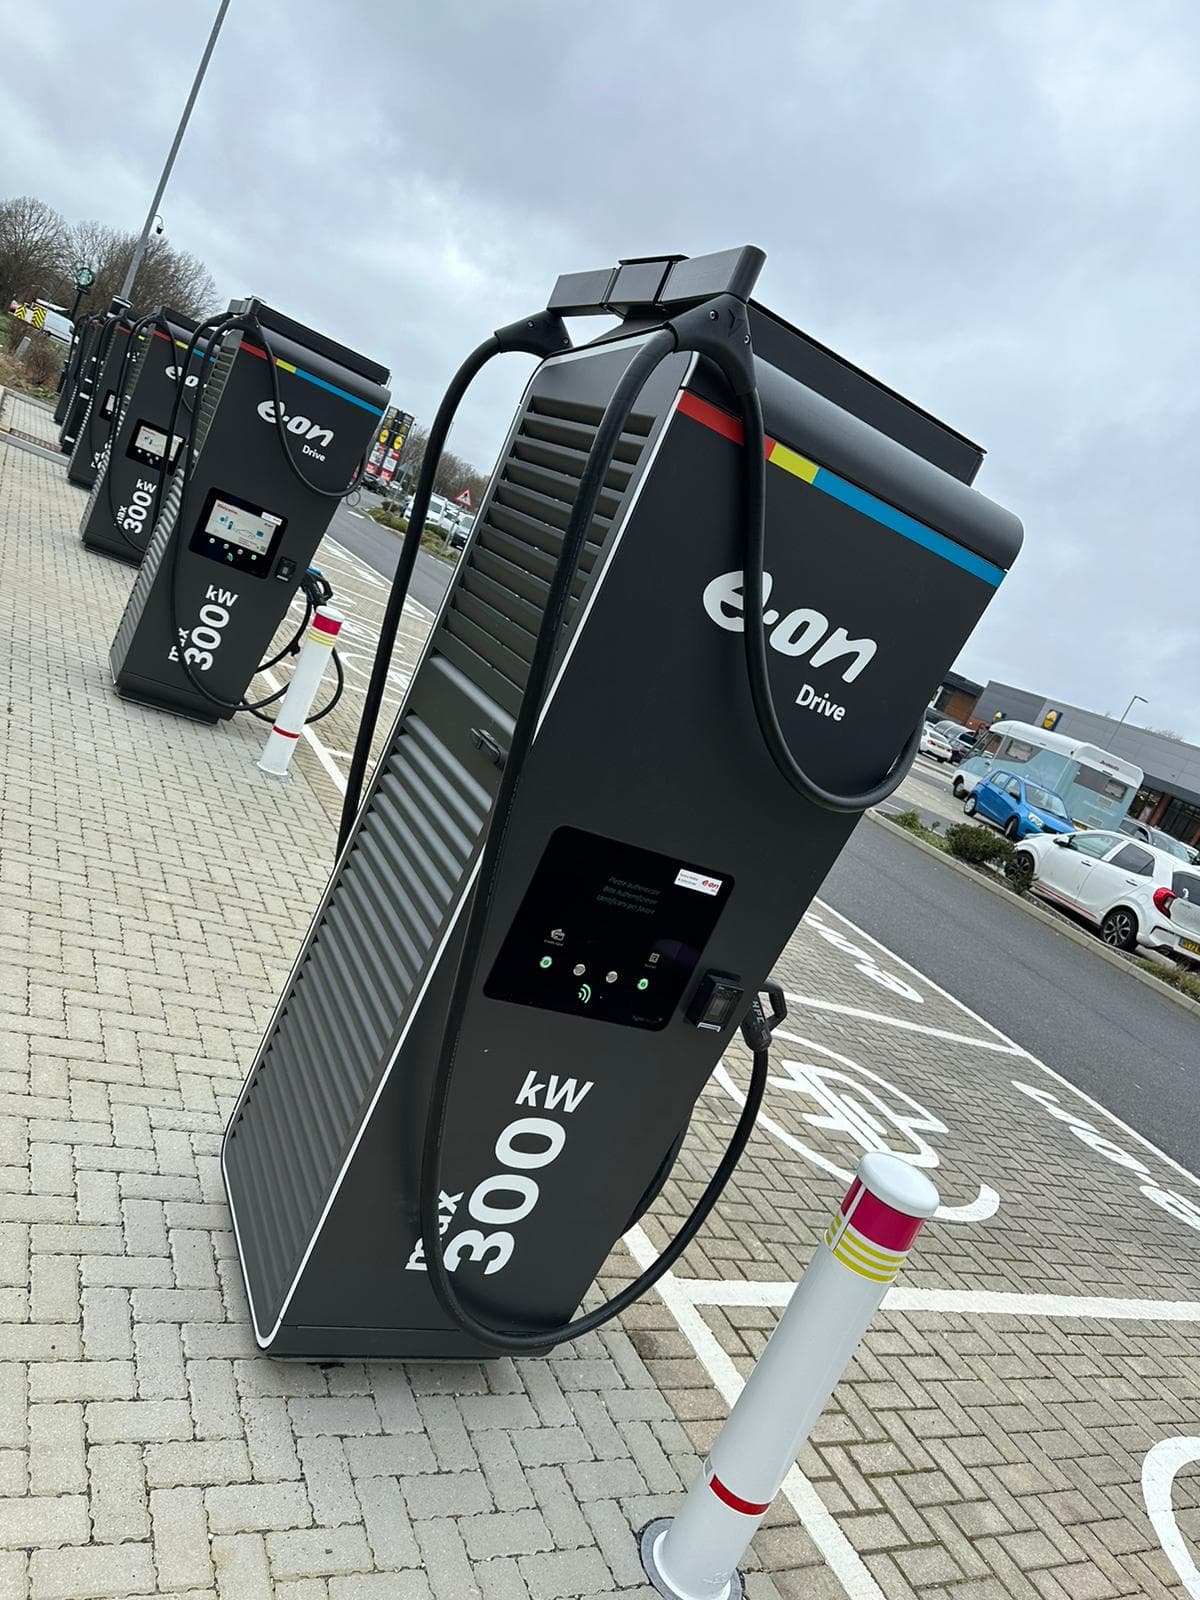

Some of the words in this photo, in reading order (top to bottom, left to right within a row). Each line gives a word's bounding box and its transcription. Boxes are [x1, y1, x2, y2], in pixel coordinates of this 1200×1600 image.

[302, 445, 326, 462] Drive
[136, 479, 157, 493] kW
[123, 490, 152, 534] 300
[205, 584, 239, 608] kW
[184, 604, 230, 671] 300
[795, 683, 846, 721] Drive
[752, 1001, 765, 1024] HPC
[515, 1070, 595, 1113] kW
[442, 1117, 566, 1275] 300
